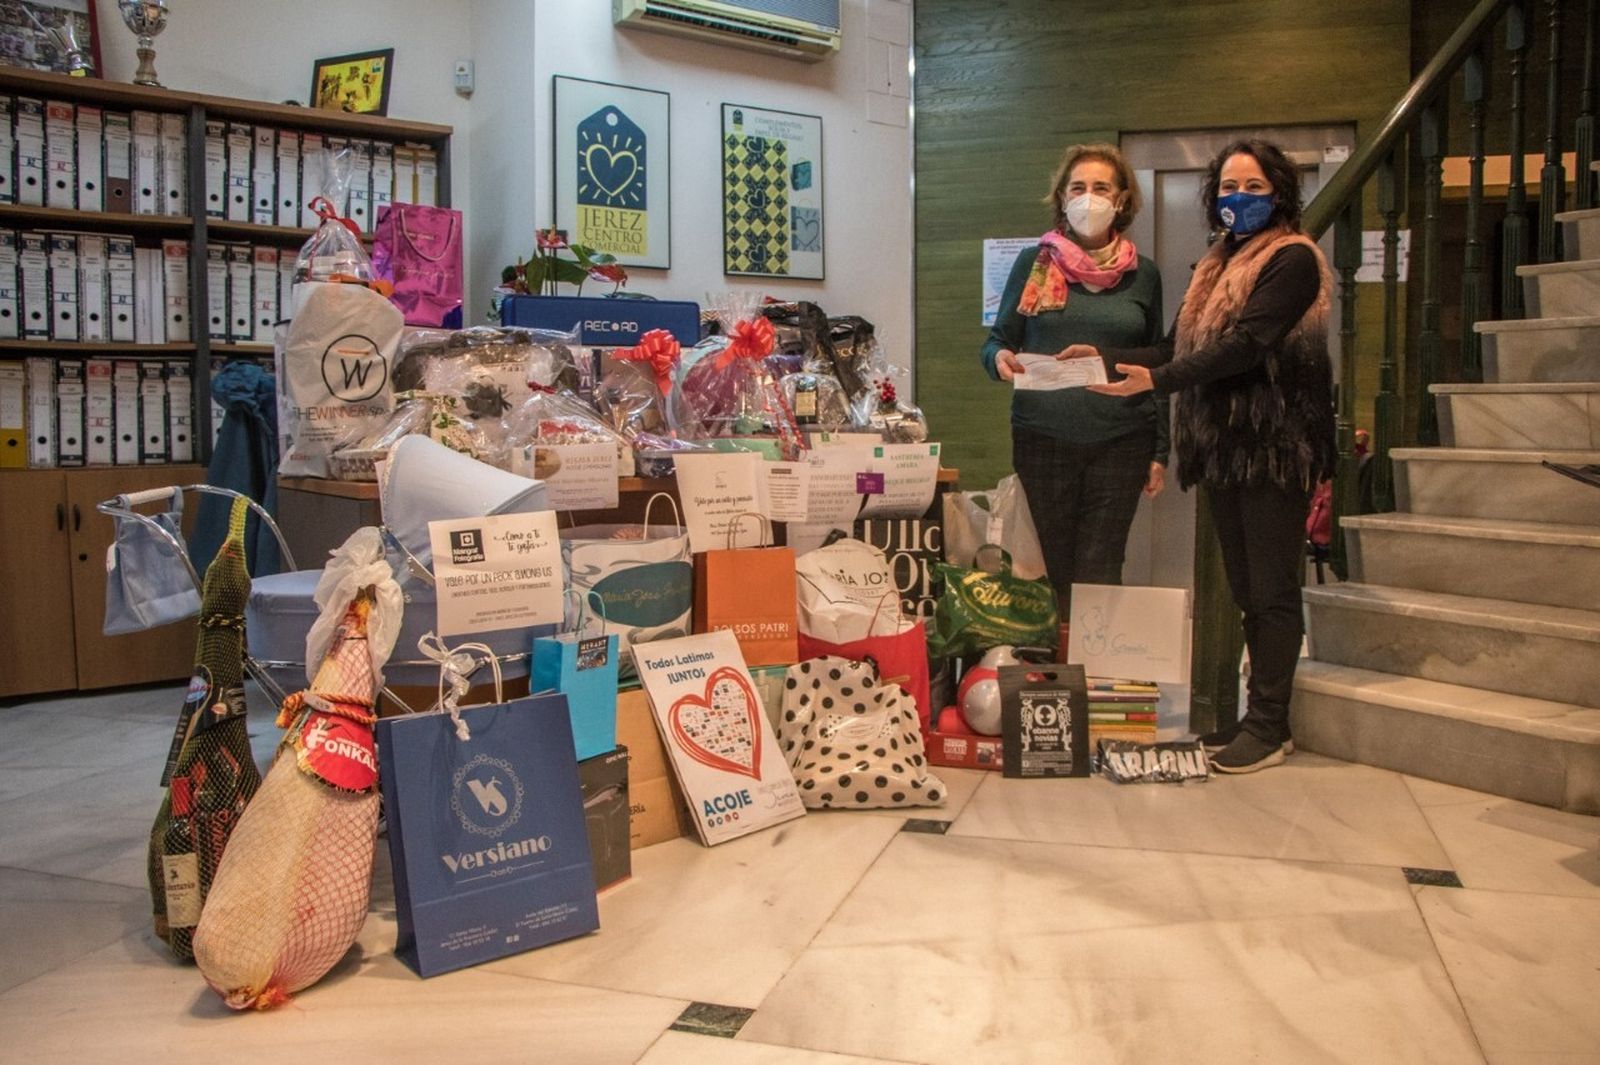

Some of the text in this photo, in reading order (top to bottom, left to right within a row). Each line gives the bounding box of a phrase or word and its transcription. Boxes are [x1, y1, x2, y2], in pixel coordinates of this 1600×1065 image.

[584, 208, 642, 231] JEREZ
[584, 228, 642, 244] CENTRO
[584, 320, 639, 333] RECORD
[340, 358, 373, 390] W
[759, 623, 789, 633] PATRI
[645, 652, 715, 671] Todos Latimos
[667, 668, 706, 684] JUNTOS
[703, 789, 753, 817] ACOJE
